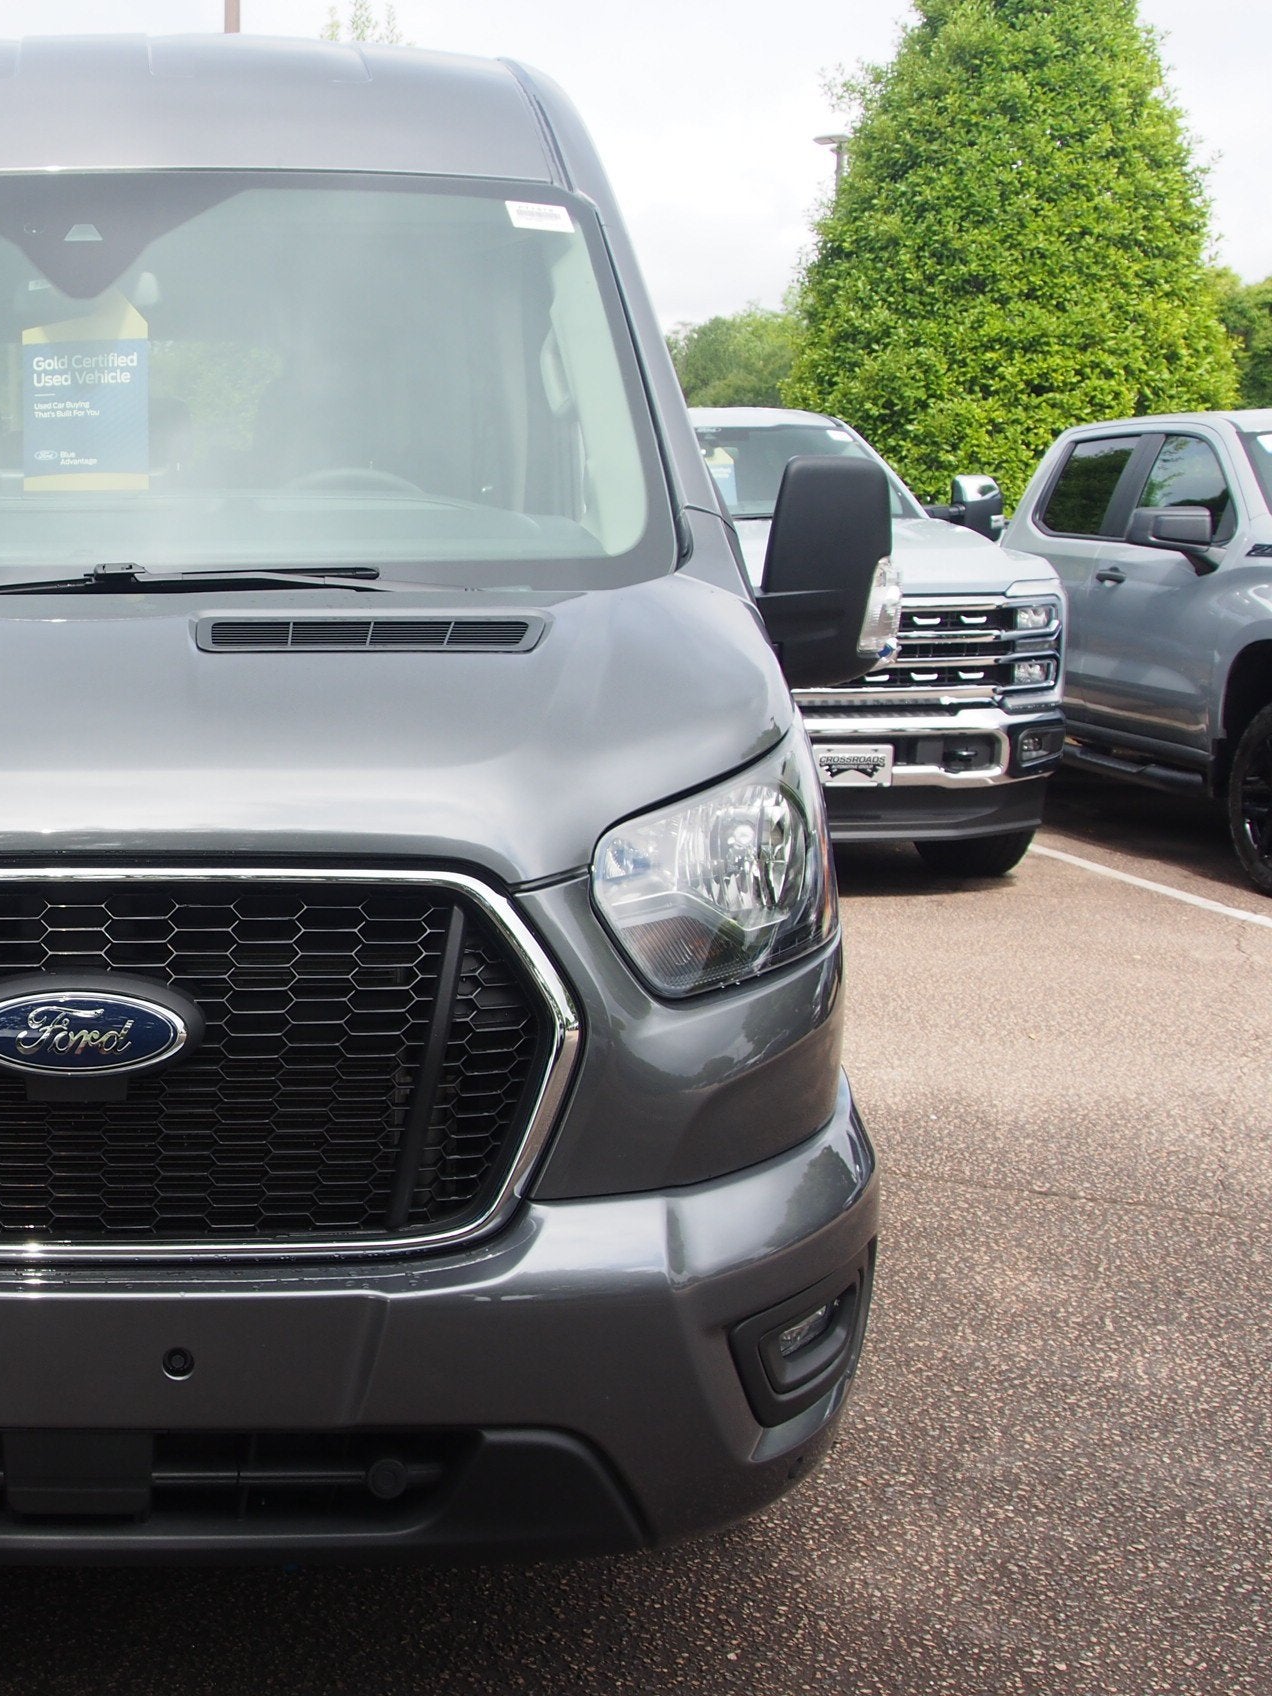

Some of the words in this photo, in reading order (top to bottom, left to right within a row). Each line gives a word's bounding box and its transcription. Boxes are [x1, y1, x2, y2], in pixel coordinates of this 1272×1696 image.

[32, 356, 68, 371] Gold
[71, 352, 138, 369] Certified
[33, 372, 71, 387] Used
[75, 369, 131, 385] Vehicle
[34, 402, 52, 410] Used
[66, 401, 90, 409] Buying
[34, 410, 56, 418] That's
[56, 410, 72, 418] Built
[73, 409, 85, 417] For
[60, 450, 76, 458] Blue
[819, 756, 886, 765] CROSSROADS
[15, 1005, 135, 1055] Ford
